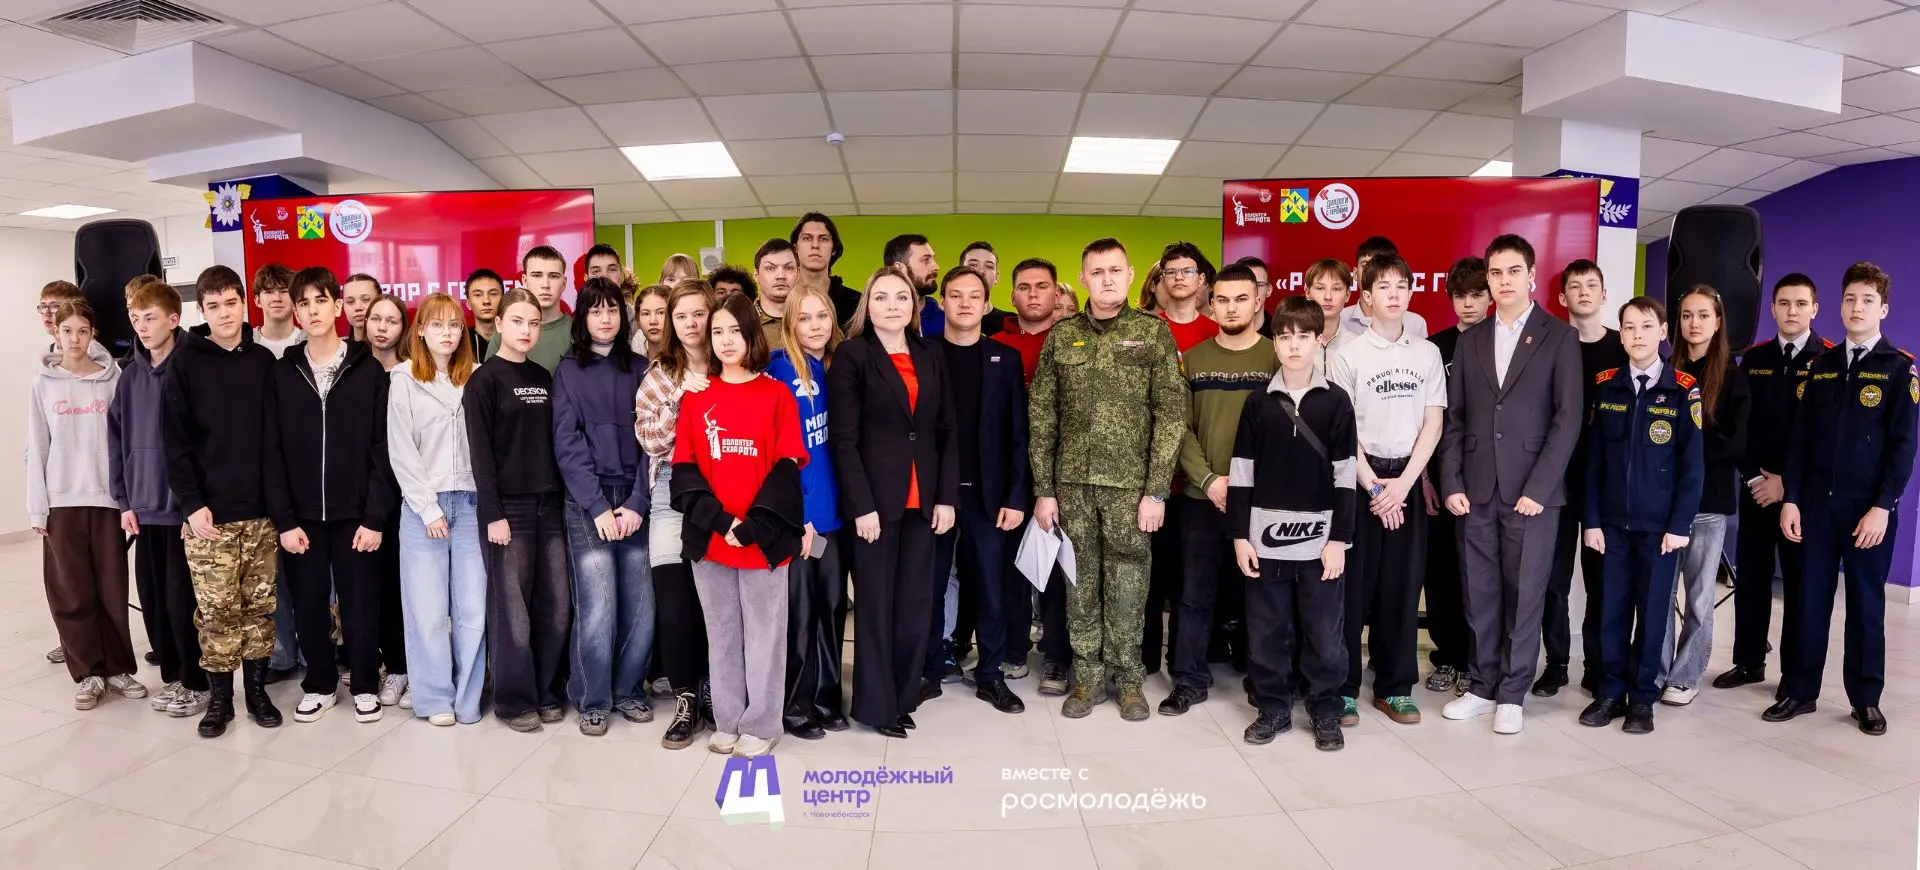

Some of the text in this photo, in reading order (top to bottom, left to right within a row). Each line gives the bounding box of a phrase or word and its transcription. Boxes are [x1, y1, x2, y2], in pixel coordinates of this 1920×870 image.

[1210, 371, 1240, 383] POLO
[513, 387, 548, 396] DECISION
[1375, 379, 1418, 393] ellesse
[722, 438, 754, 447] ВОЛОНТЕР
[738, 446, 758, 457] РОТА
